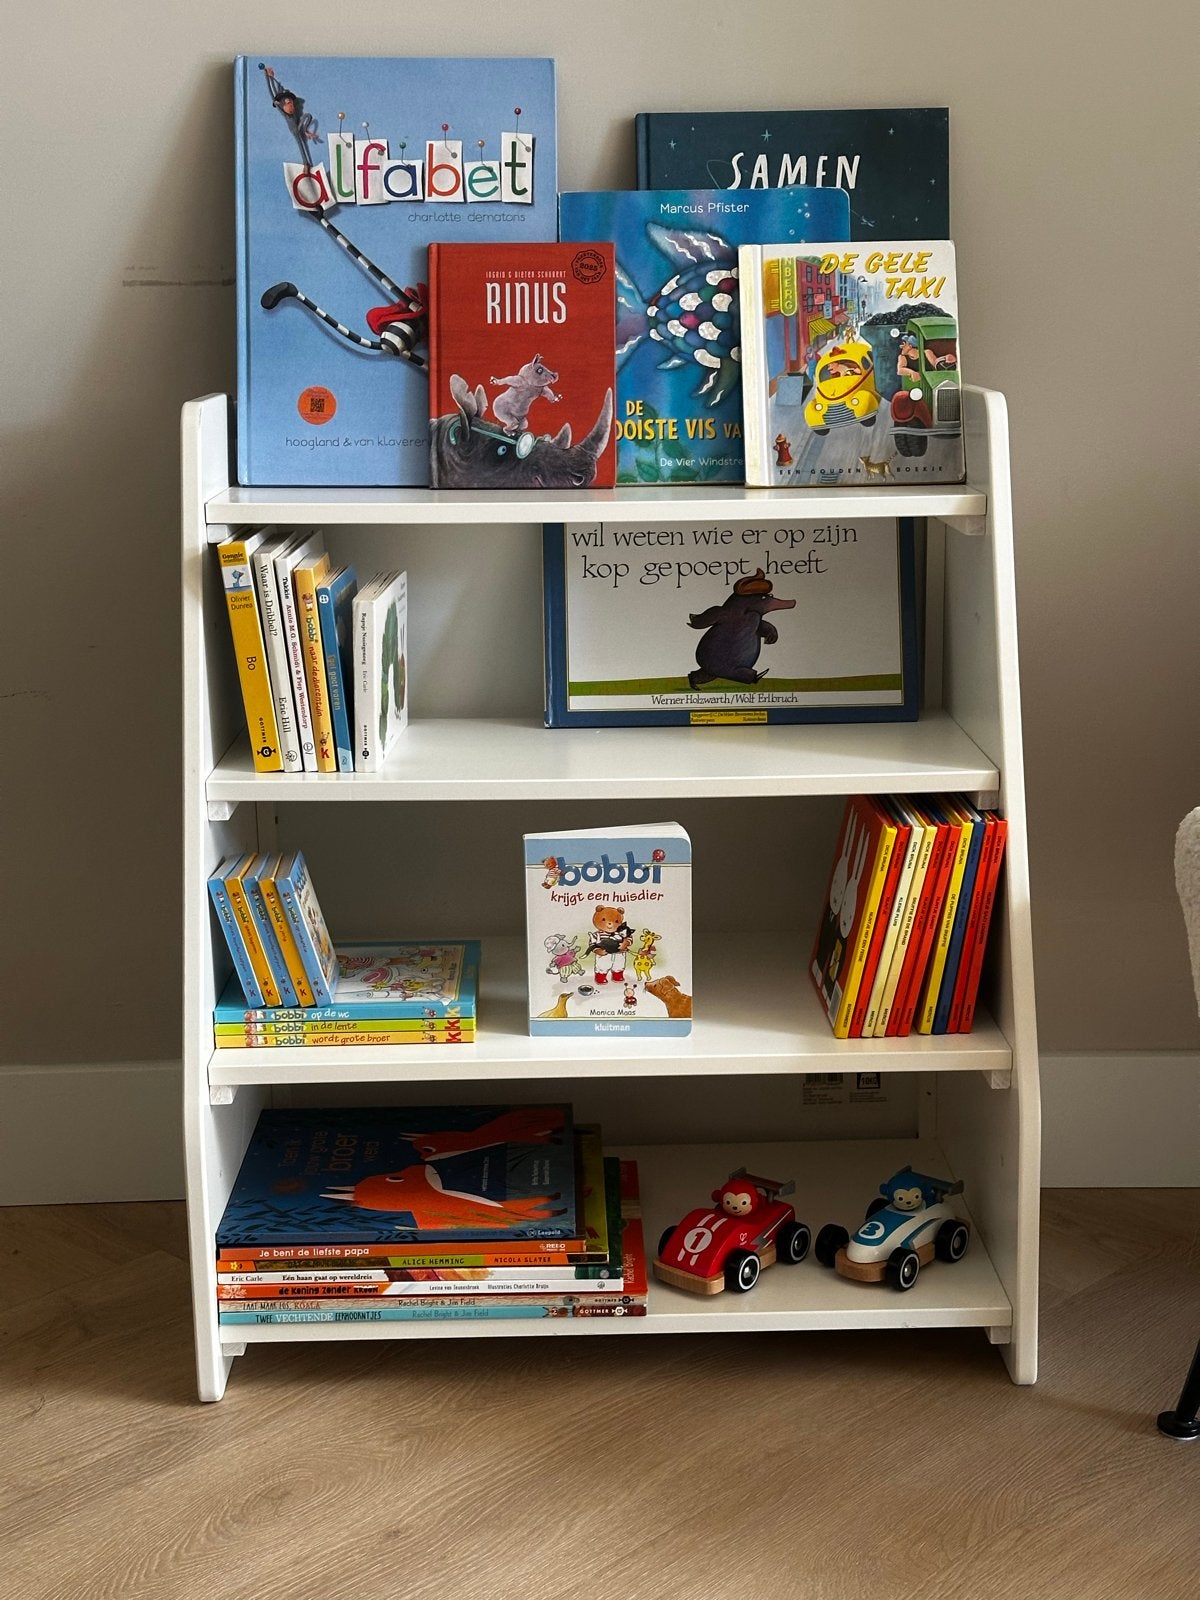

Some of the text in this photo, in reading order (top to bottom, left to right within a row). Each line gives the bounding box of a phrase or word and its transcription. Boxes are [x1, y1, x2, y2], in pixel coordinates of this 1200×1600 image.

[293, 141, 528, 208] alfabet
[727, 152, 861, 189] SAMEN
[660, 202, 749, 214] Marcus Pfister
[408, 212, 526, 223] charlotte dematons
[580, 262, 598, 271] 2025
[819, 251, 933, 275] DE GELE
[485, 270, 506, 279] INGRID
[514, 270, 535, 278] DIETER
[537, 270, 567, 278] SCHUBERT
[885, 275, 947, 299] TAXI
[485, 282, 567, 324] RINUS
[626, 400, 644, 416] DE
[685, 418, 717, 439] VIS
[285, 436, 430, 450] hoogland & van klaveren
[660, 458, 673, 467] De
[675, 457, 695, 467] Vier
[810, 467, 861, 475] GOUDEN
[571, 522, 858, 549] wil weten wie er op zijn
[581, 554, 630, 588] kop
[765, 550, 828, 575] heeft
[260, 564, 278, 636] Waar is Dribbel?
[247, 656, 256, 670] Bo
[306, 616, 323, 717] bobbi naar de dierentuin
[291, 641, 301, 669] Schmidt
[299, 692, 308, 729] Westendorp
[332, 687, 341, 711] varen
[651, 695, 685, 705] Werner
[758, 692, 798, 703] Erlbruch
[279, 697, 291, 733] Eric Hill
[321, 747, 330, 759] K
[556, 850, 662, 886] bobbi
[551, 890, 664, 906] krijgt een huisdier
[273, 1009, 306, 1020] bobbi
[311, 1012, 322, 1020] op
[324, 1009, 336, 1017] de
[273, 1021, 358, 1032] bobbi in de lente
[444, 1018, 460, 1030] K
[594, 1023, 631, 1031] kluitman
[275, 1033, 391, 1045] bobbi wordt grote broer
[446, 1031, 462, 1043] K
[690, 1231, 706, 1250] 1
[259, 1247, 369, 1258] Je bent de liefste papa
[402, 1257, 426, 1265] ALICE
[429, 1257, 465, 1265] HEMMING
[494, 1256, 521, 1264] NICOLA
[338, 1273, 372, 1281] wereldreis
[278, 1287, 289, 1295] de
[322, 1285, 351, 1294] zonder
[398, 1299, 419, 1307] Rachel
[420, 1299, 438, 1307] Bright
[256, 1314, 272, 1324] TWEE
[275, 1313, 334, 1323] VECHTENDE
[412, 1310, 433, 1318] Rachel
[434, 1310, 453, 1318] Bright
